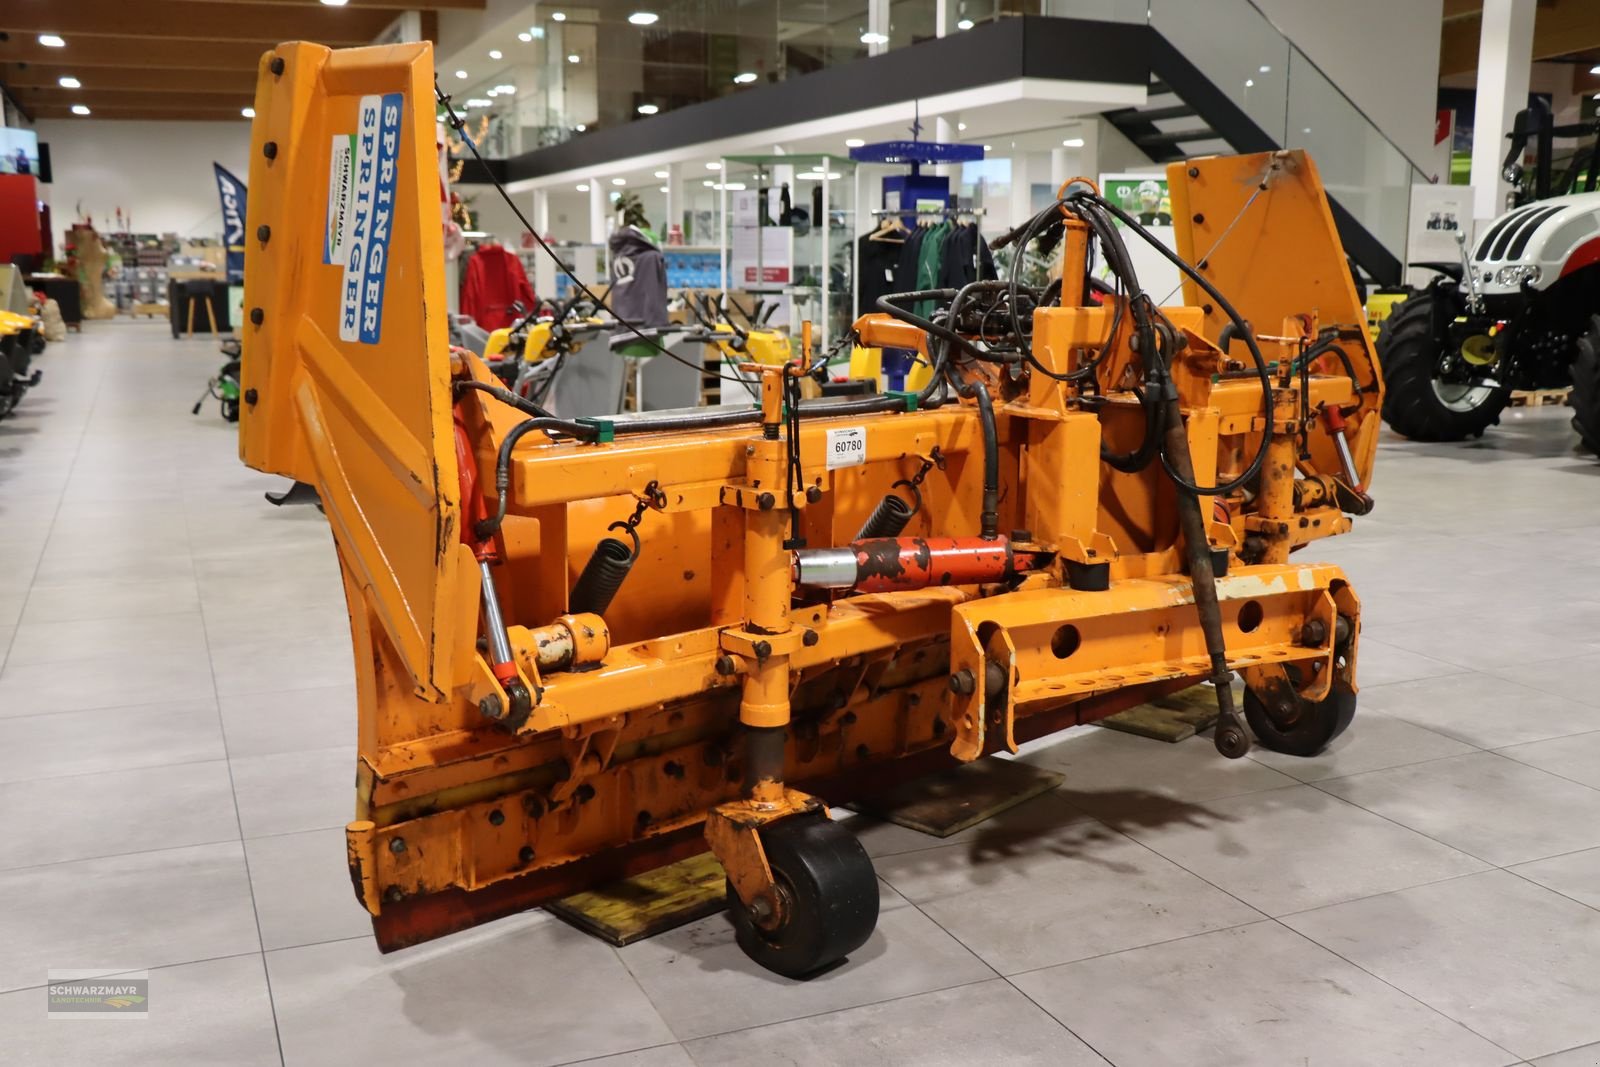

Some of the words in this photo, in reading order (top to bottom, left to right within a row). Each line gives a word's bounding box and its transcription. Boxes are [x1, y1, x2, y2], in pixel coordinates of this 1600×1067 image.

[337, 147, 350, 246] SCHWARZMAYR
[345, 108, 376, 331] SPRINGER
[364, 106, 398, 333] SPRINGER
[835, 440, 862, 453] 60780
